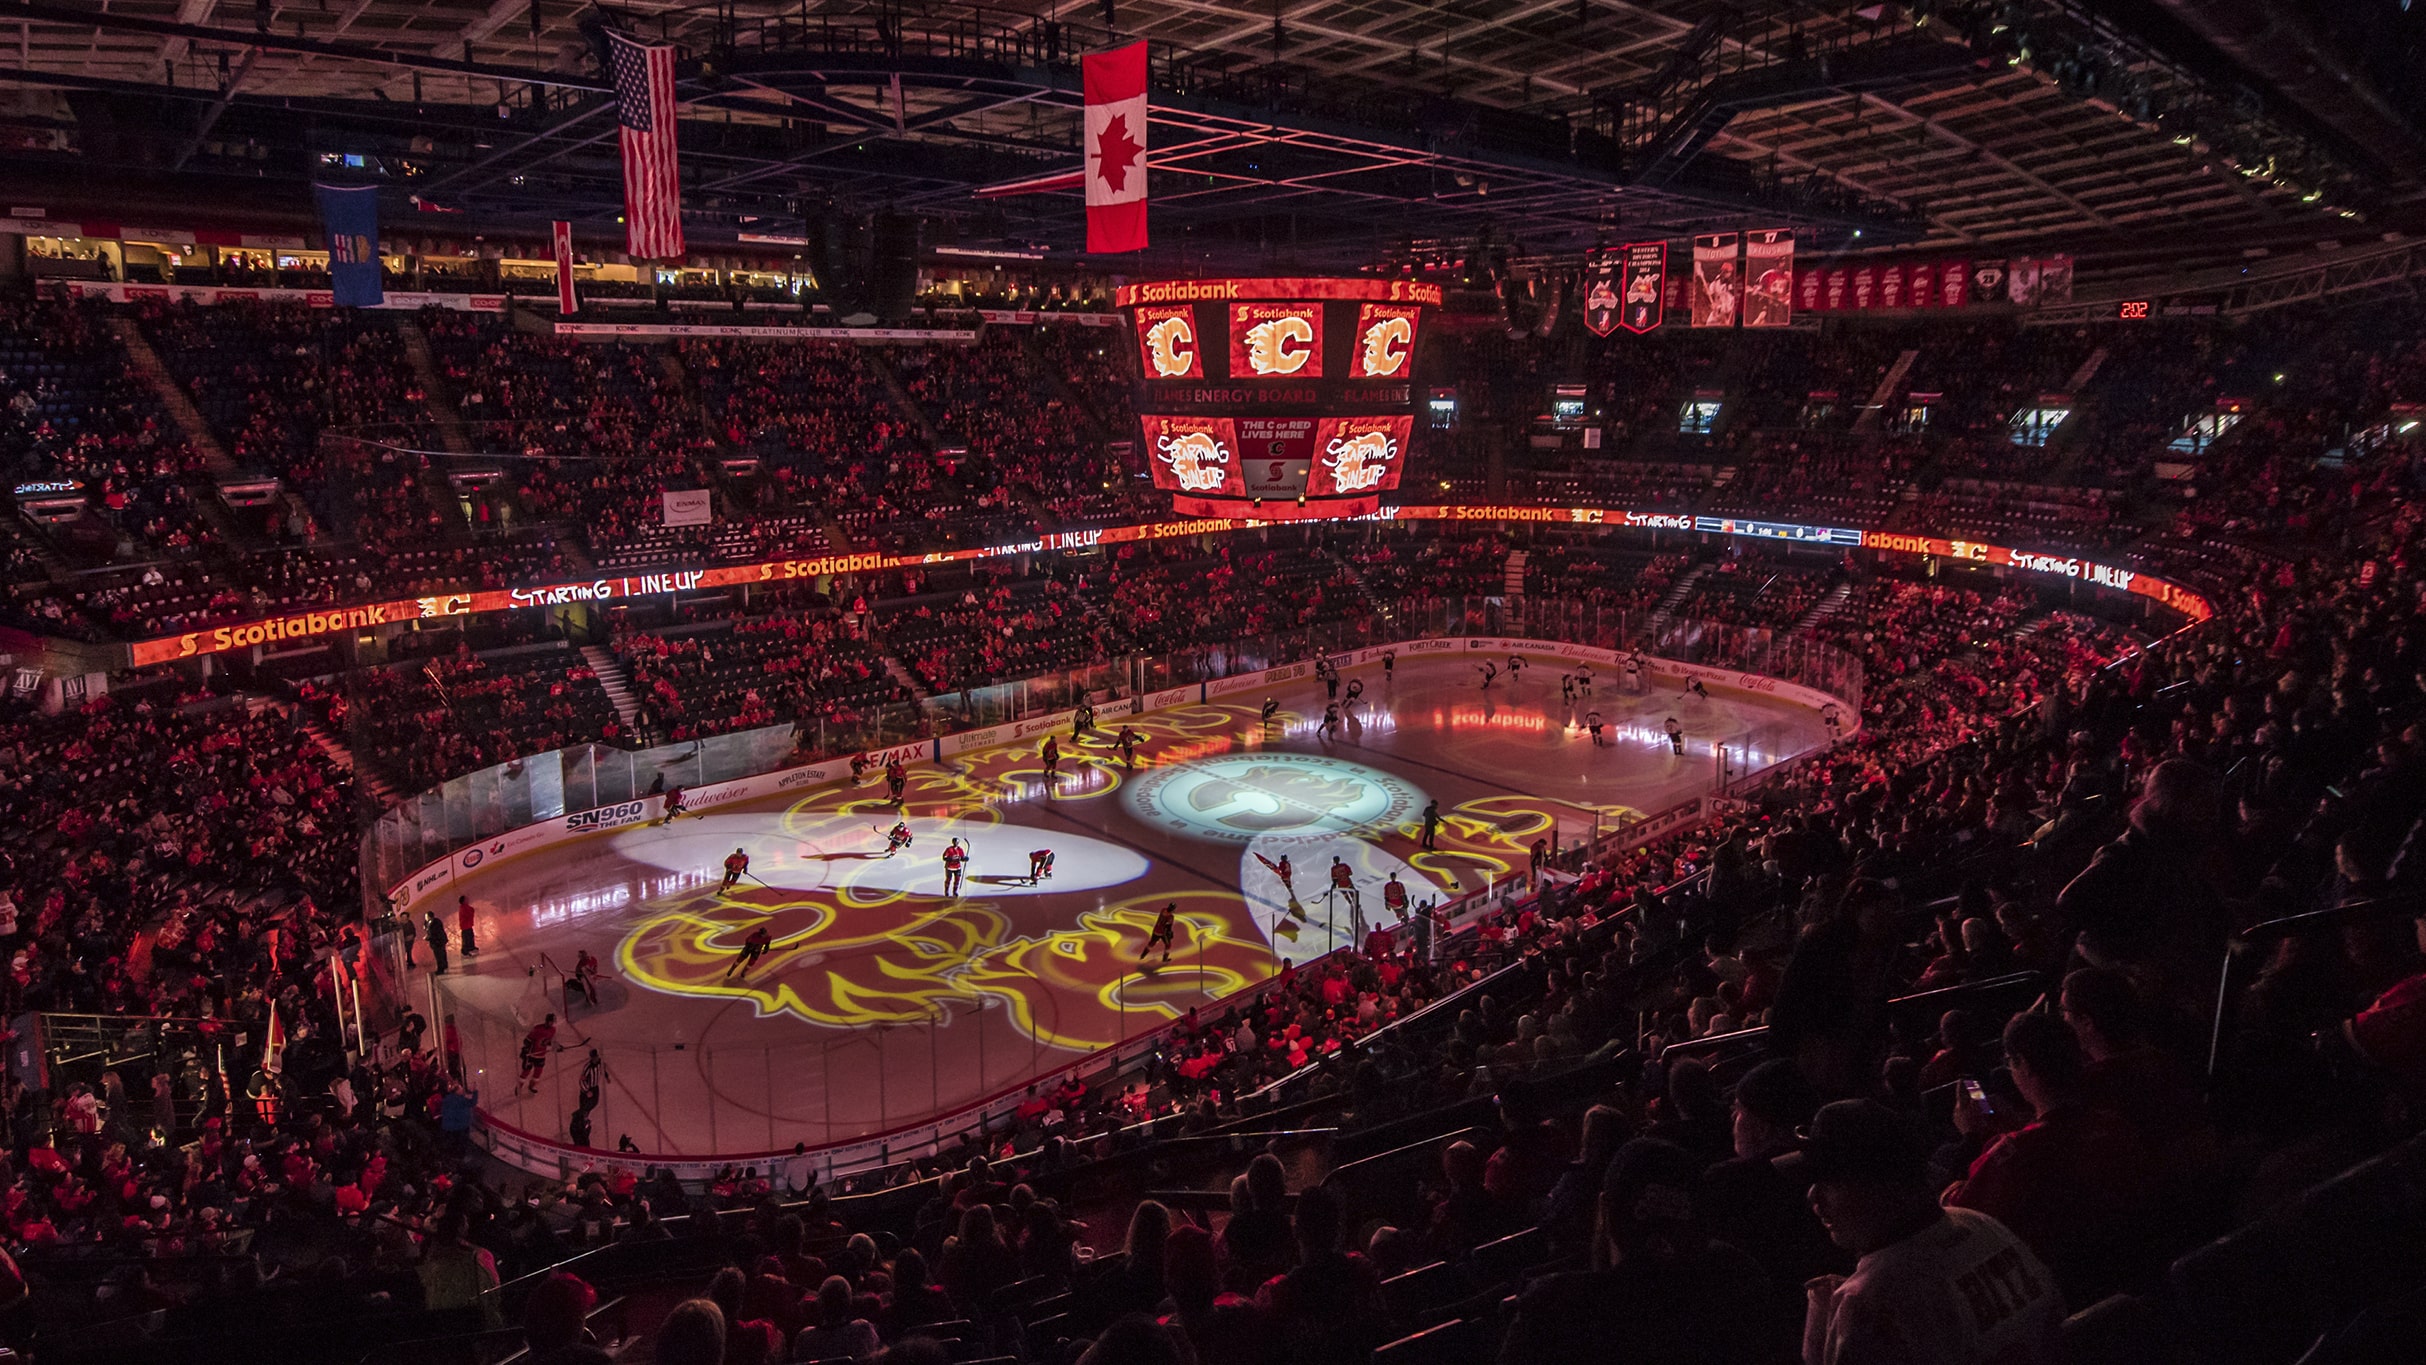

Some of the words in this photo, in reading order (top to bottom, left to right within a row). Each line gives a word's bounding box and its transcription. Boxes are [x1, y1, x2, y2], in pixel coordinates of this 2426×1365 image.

[1764, 232, 1778, 244] 17
[1142, 280, 1239, 301] Scotiabank
[1147, 308, 1189, 320] Scotiabank
[1253, 308, 1313, 319] Scotiabank
[1374, 307, 1415, 319] Scotiabank
[1195, 389, 1252, 402] ENERGY
[1258, 389, 1316, 402] BOARD
[1171, 423, 1213, 434] Scotiabank
[1243, 421, 1265, 430] THE
[1268, 421, 1275, 430] C
[1287, 421, 1311, 430] RED
[1349, 422, 1391, 433] Scotiabank
[1241, 430, 1273, 439] LIVES
[1275, 430, 1305, 439] HERE
[1251, 484, 1297, 492] Scotiabank
[1456, 505, 1553, 522] Scotiabank
[1624, 511, 1691, 530] STARTING
[1154, 518, 1232, 538] Scotiabank
[1050, 529, 1103, 551] LINEUP
[2008, 549, 2080, 577] STARTING
[2083, 561, 2135, 590] LINEUP
[510, 580, 611, 609] STARTING
[623, 570, 704, 597] LINEUP
[214, 603, 387, 652] Scotiabank
[1409, 641, 1429, 652] FORTY
[1429, 639, 1452, 650] CREEK
[1525, 643, 1556, 651] CANADA
[1560, 644, 1611, 661] Budweiser
[12, 673, 41, 690] AVI
[1264, 667, 1292, 684] PIZZA
[1293, 664, 1305, 677] 73
[65, 677, 85, 698] AVI
[1212, 676, 1257, 694] Budweiser
[1101, 706, 1113, 715] AIR
[1026, 716, 1071, 733] Scotiabank
[958, 729, 996, 745] Ultimate
[778, 770, 806, 788] APPLETON
[807, 770, 825, 780] ESTATE
[566, 801, 643, 830] SN960
[600, 820, 619, 829] THE
[621, 815, 641, 825] FAN
